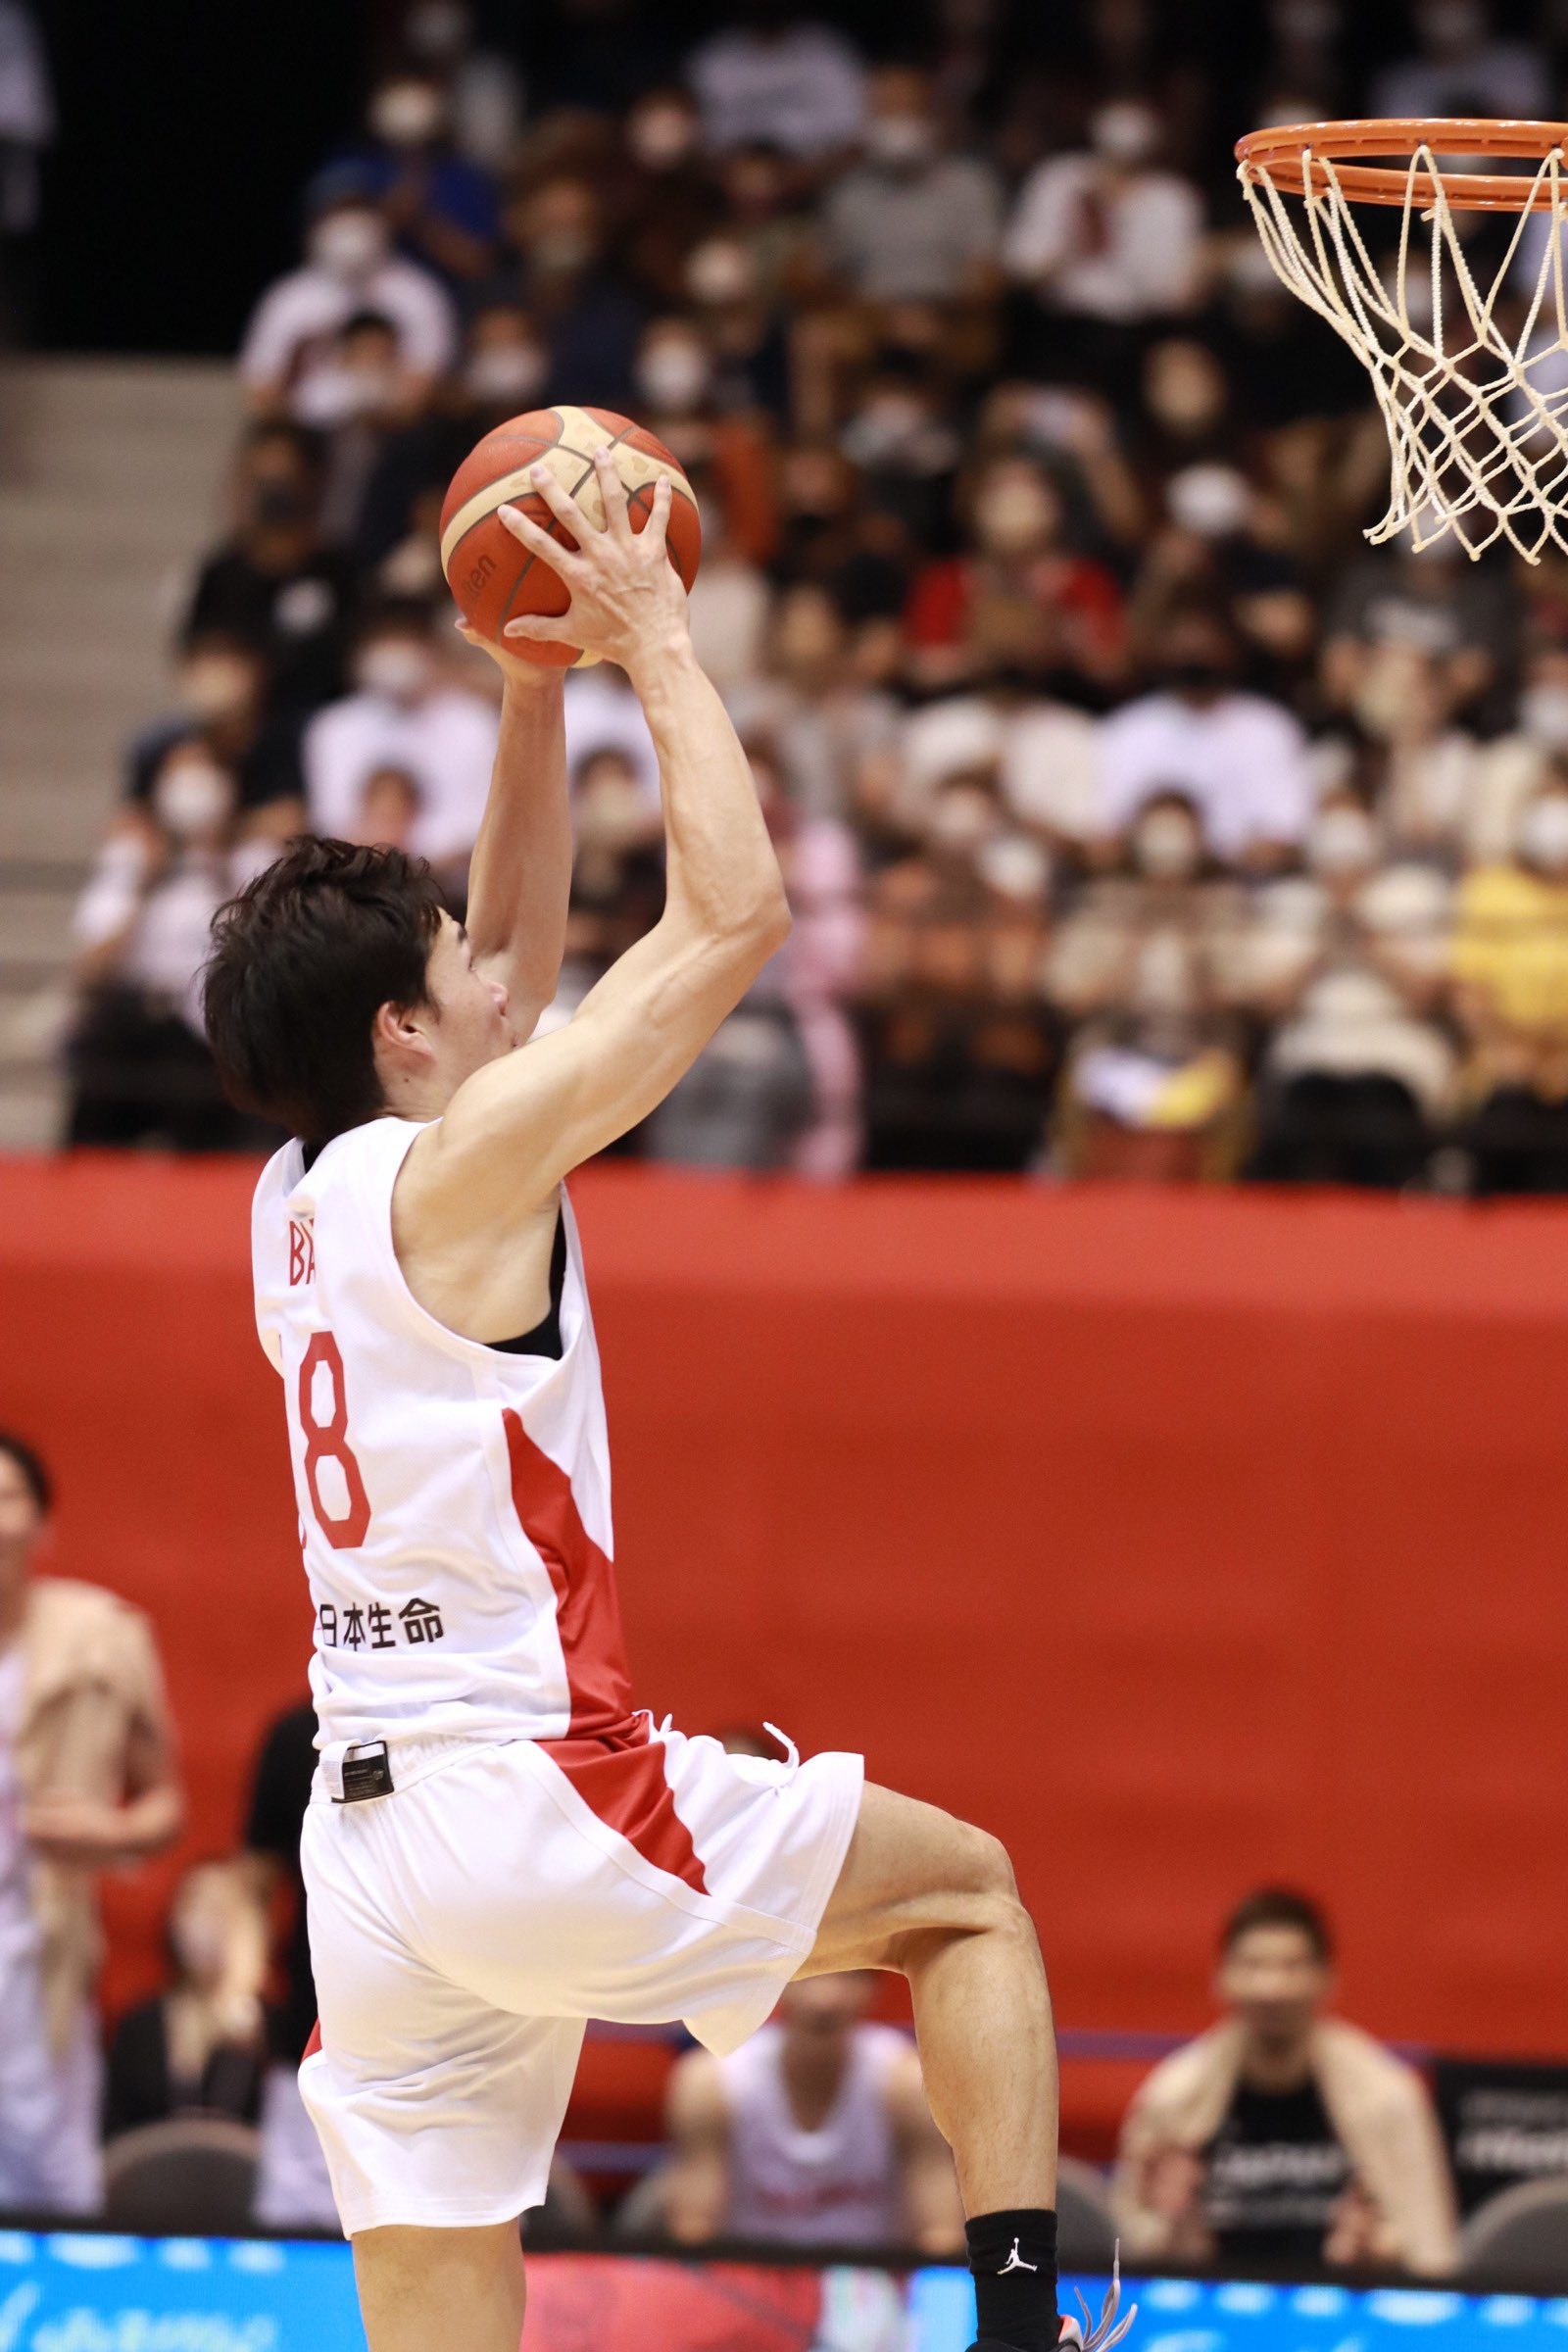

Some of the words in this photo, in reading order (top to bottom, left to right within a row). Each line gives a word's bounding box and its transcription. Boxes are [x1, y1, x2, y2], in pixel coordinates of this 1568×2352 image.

[298, 1331, 371, 1549] 8
[319, 1597, 444, 1652] 日本生命
